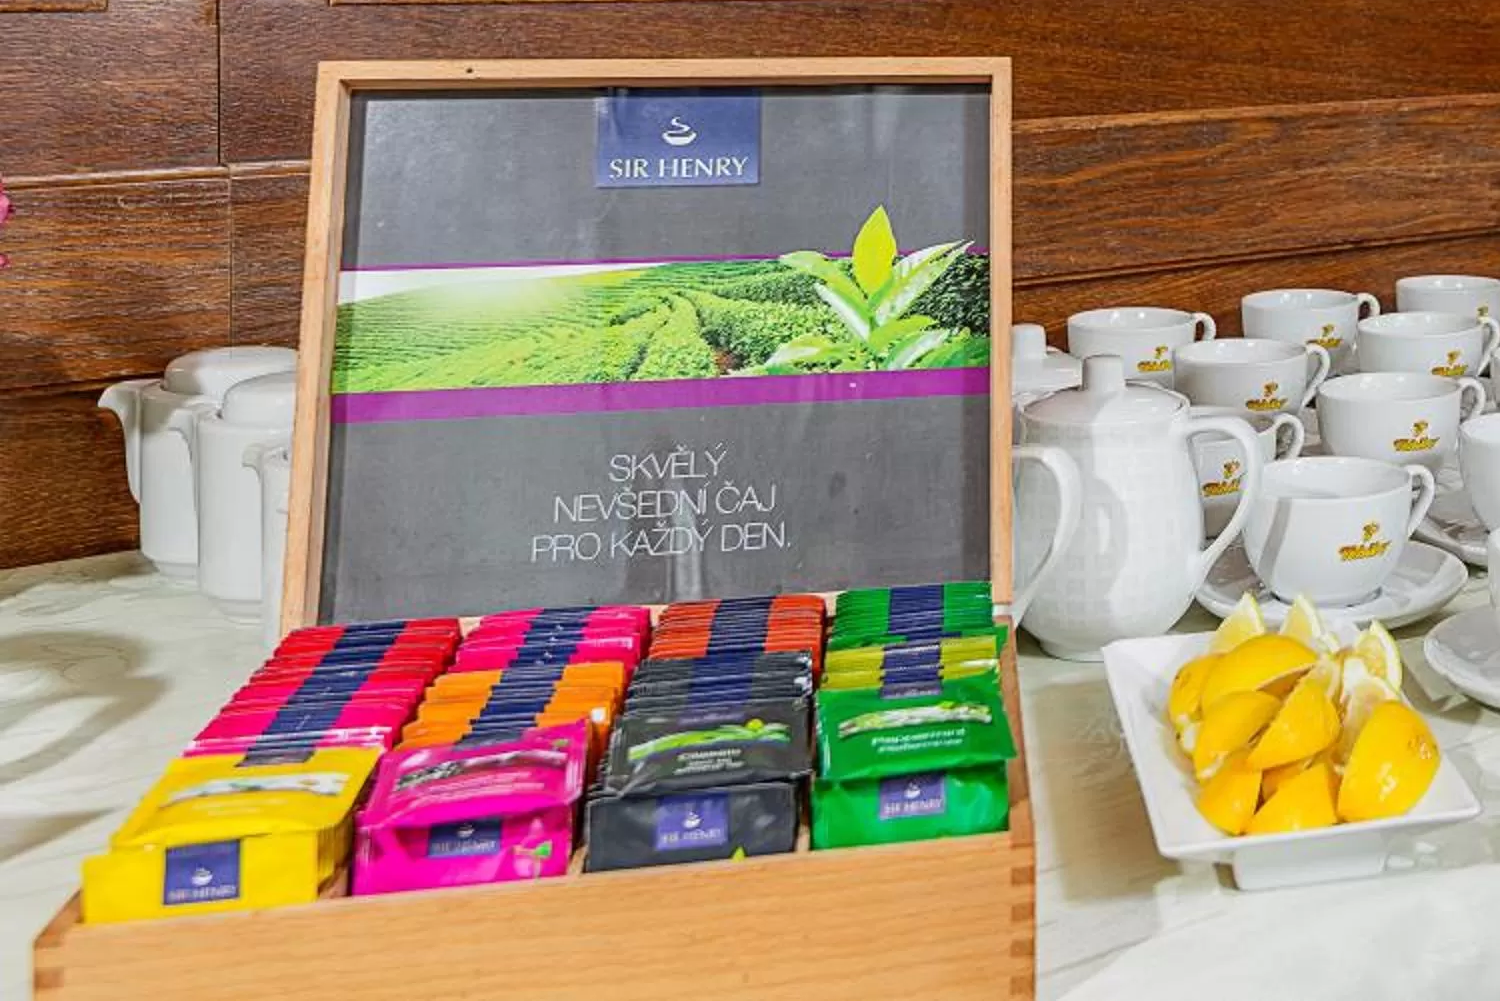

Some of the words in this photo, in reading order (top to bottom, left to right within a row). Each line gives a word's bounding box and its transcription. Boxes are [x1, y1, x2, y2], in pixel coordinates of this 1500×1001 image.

[609, 158, 649, 179] SIR
[658, 156, 749, 178] HENRY
[608, 442, 728, 482] SKVĚLÝ
[553, 481, 710, 523] NEVŠEDNÍ
[715, 480, 777, 515] ČAJ
[530, 532, 600, 563] PRO
[610, 519, 714, 559] KAŽDÝ
[720, 521, 792, 552] DEN.
